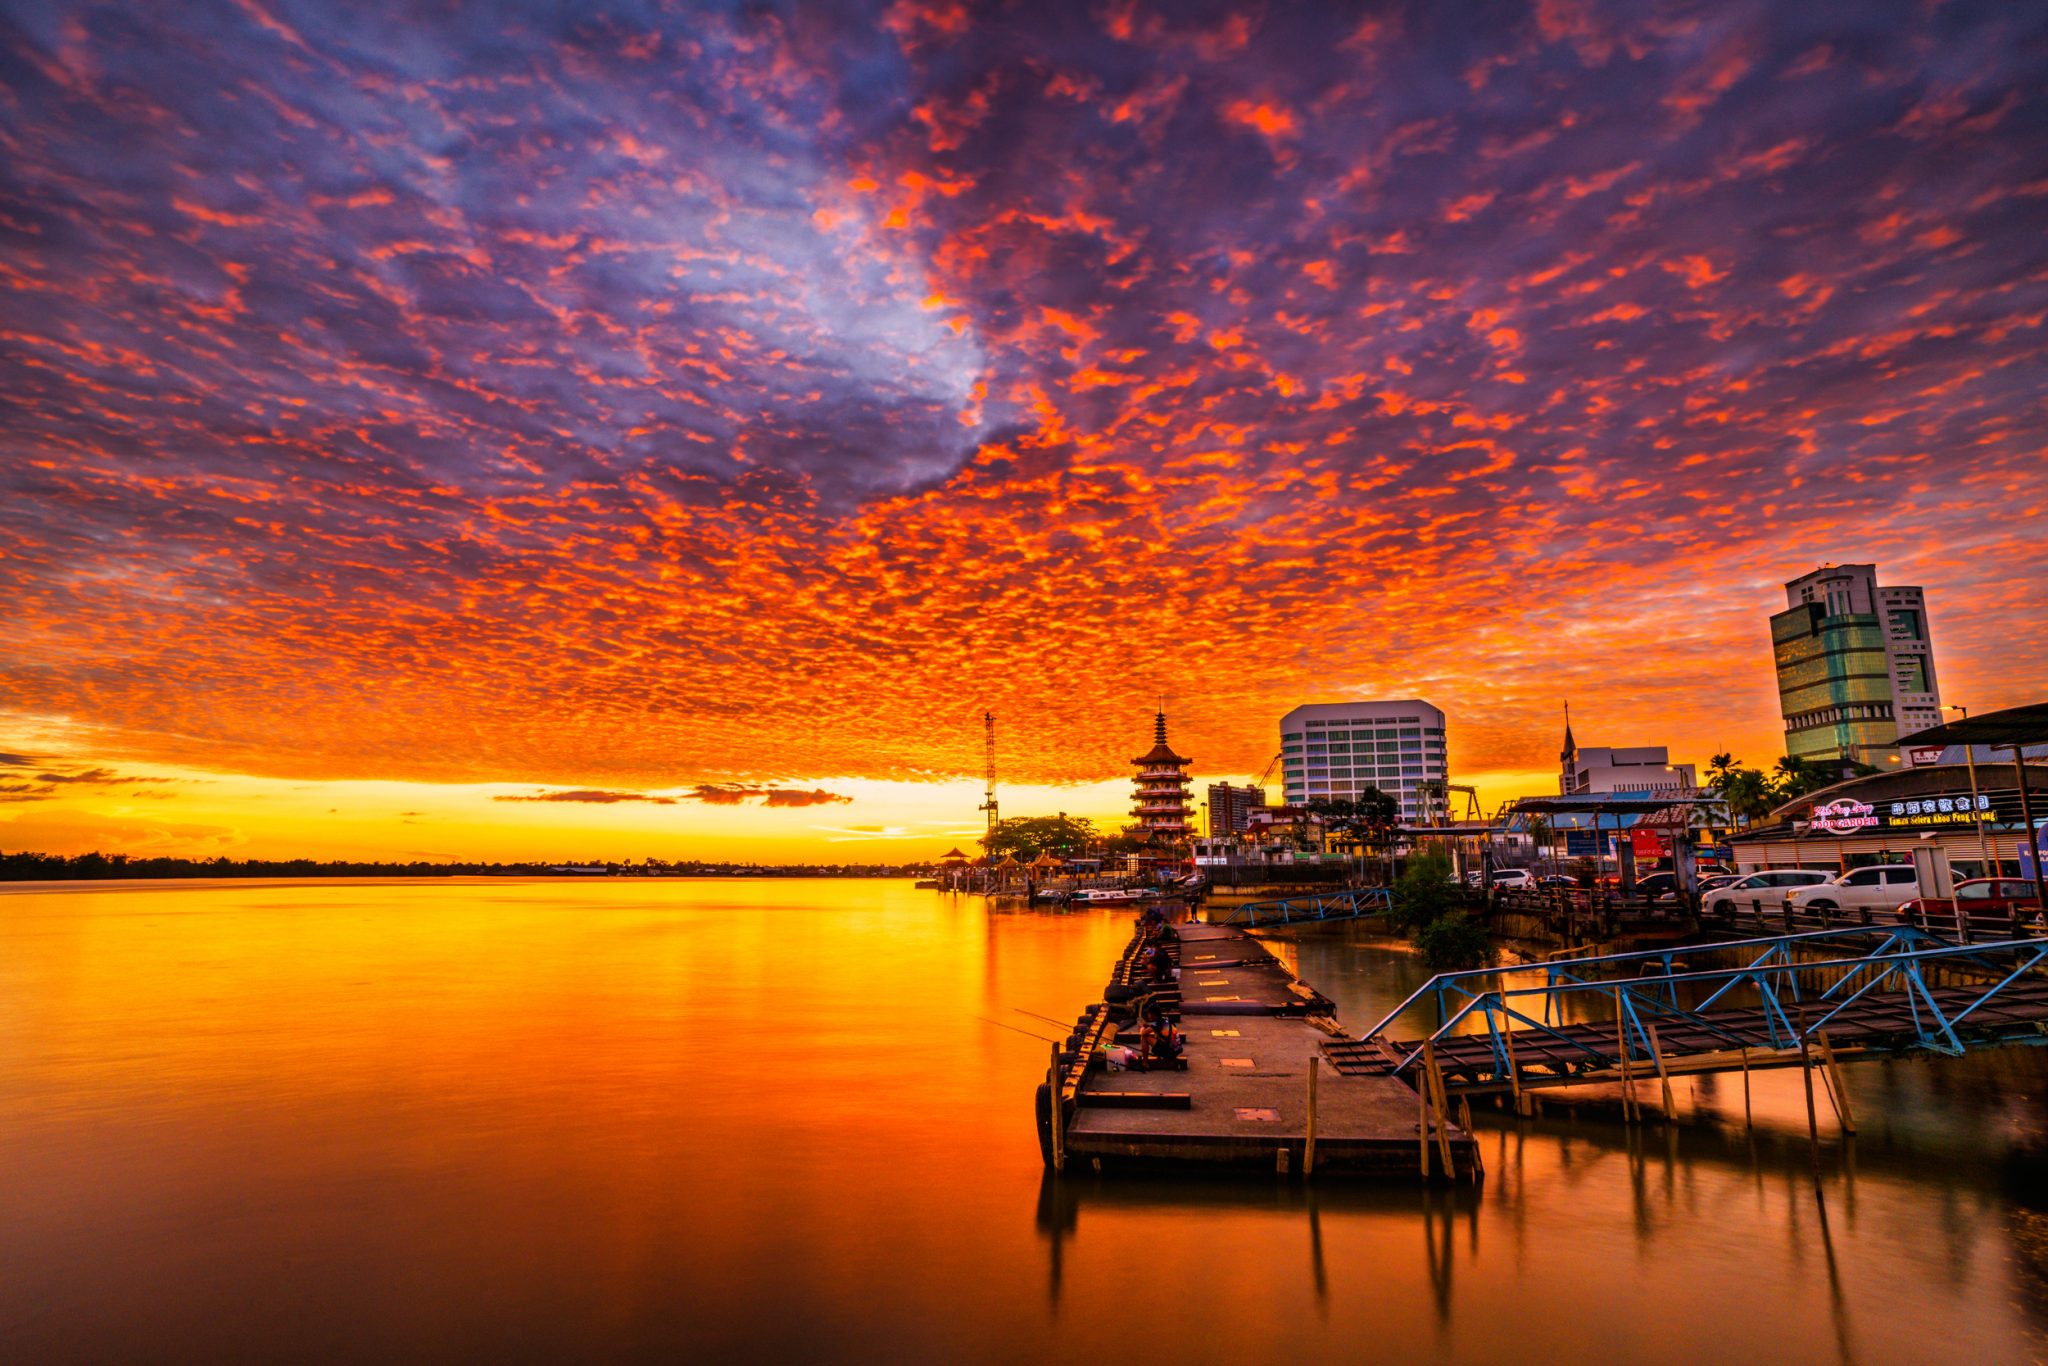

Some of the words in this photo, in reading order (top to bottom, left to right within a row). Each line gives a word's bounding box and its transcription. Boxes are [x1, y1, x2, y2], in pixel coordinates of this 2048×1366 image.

[1811, 820, 1835, 830] FOOD
[1837, 817, 1879, 828] GARDEN
[1933, 813, 1950, 824] Khoo
[1952, 811, 1970, 824] Peng
[1972, 811, 1996, 823] Long
